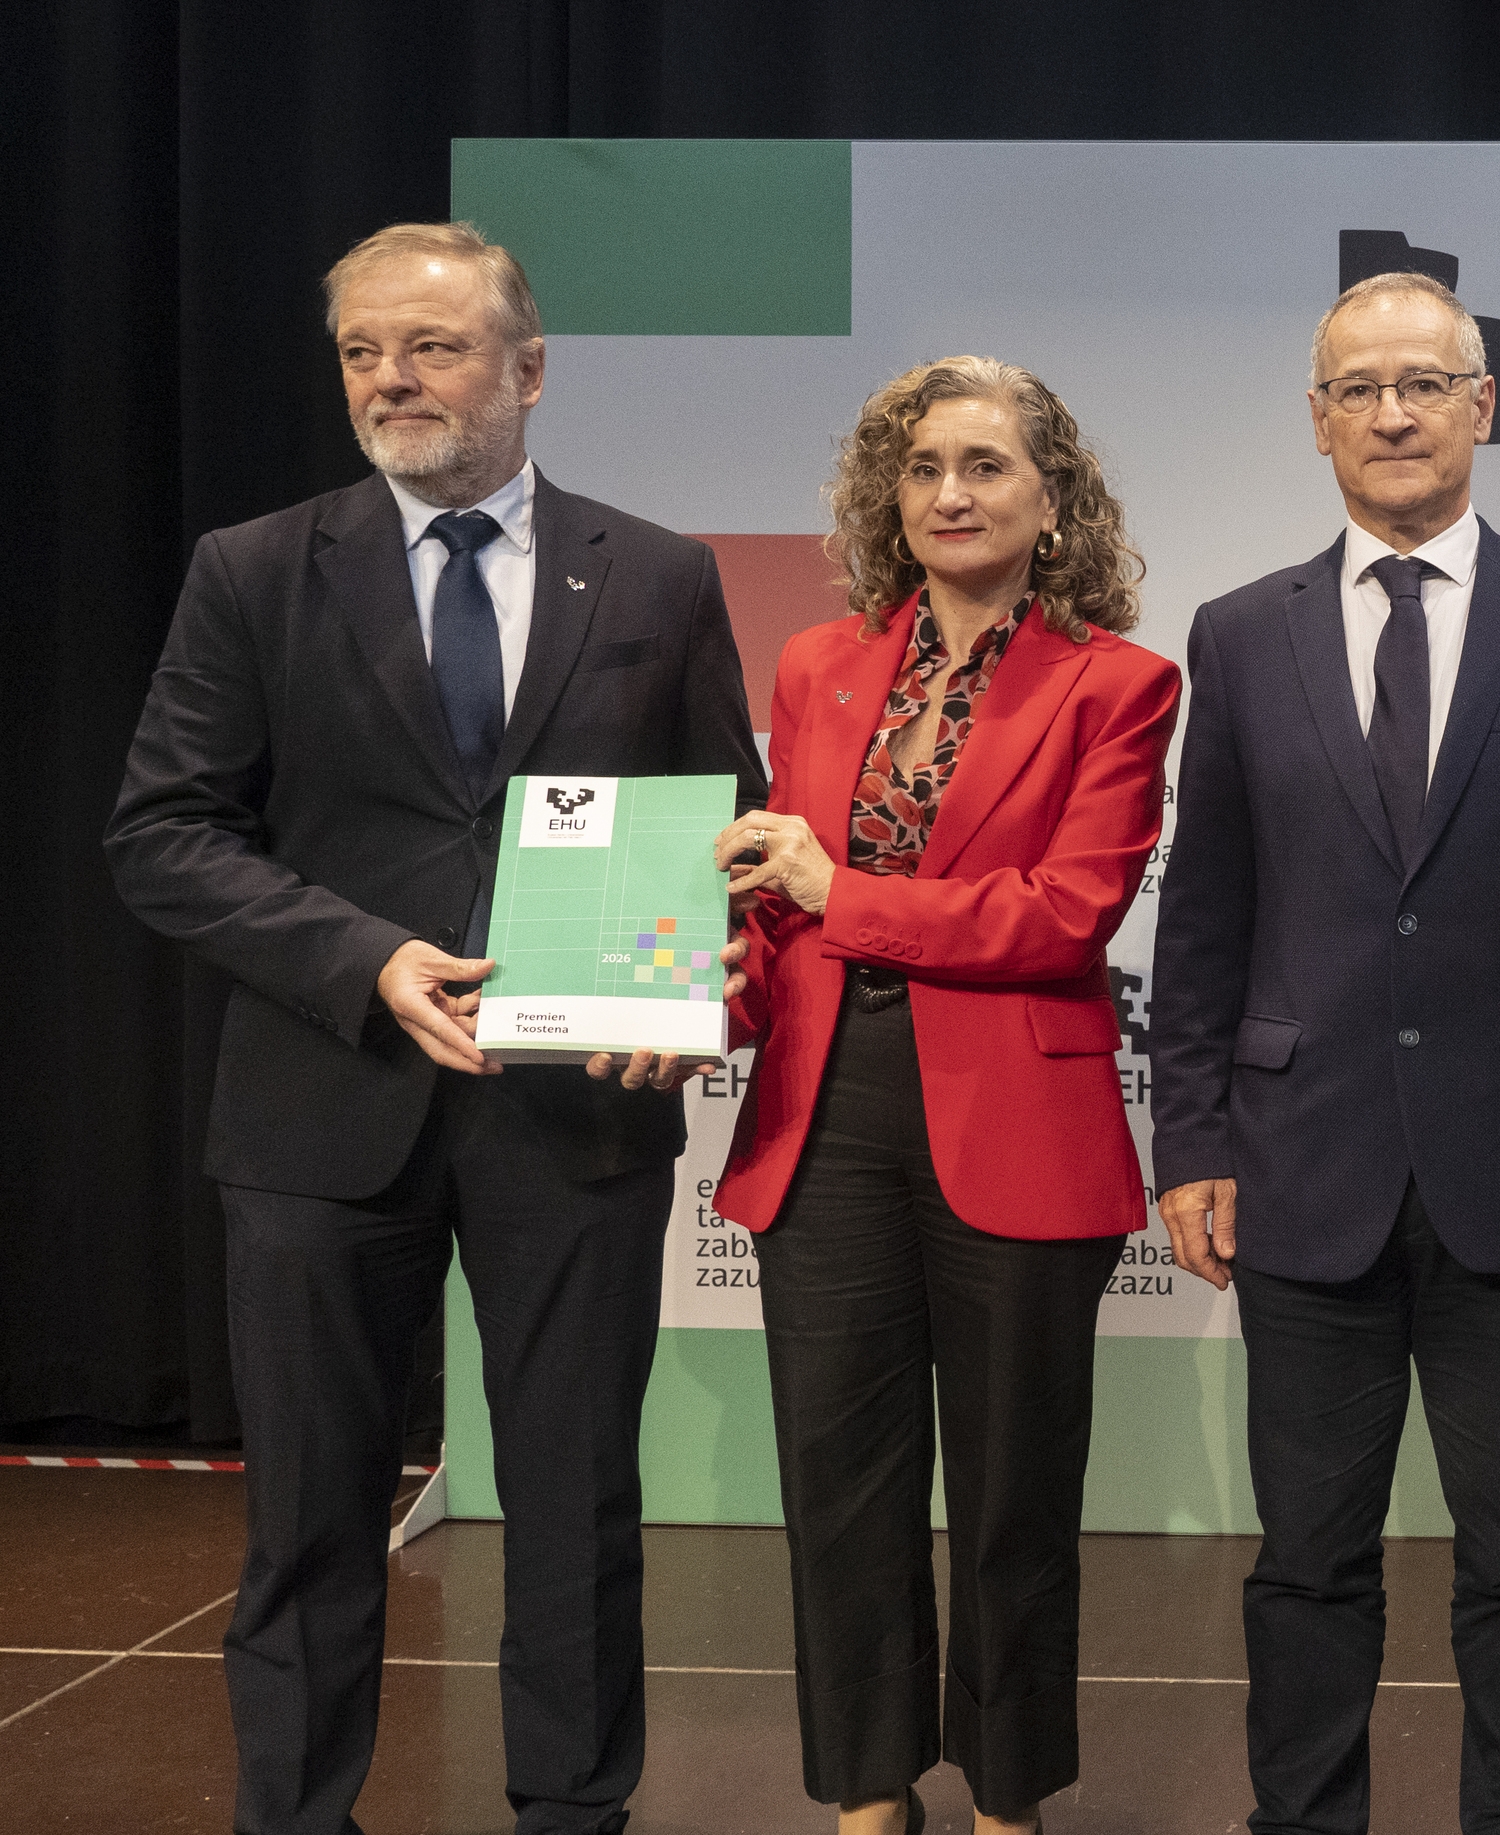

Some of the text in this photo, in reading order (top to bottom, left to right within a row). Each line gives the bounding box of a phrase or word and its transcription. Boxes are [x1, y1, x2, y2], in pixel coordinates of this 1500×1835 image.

[549, 818, 587, 831] EHU
[601, 953, 632, 963] 2026
[516, 1012, 567, 1022] Premien
[515, 1024, 570, 1035] Txostena
[702, 1063, 749, 1098] EH
[1105, 1274, 1174, 1296] zazu
